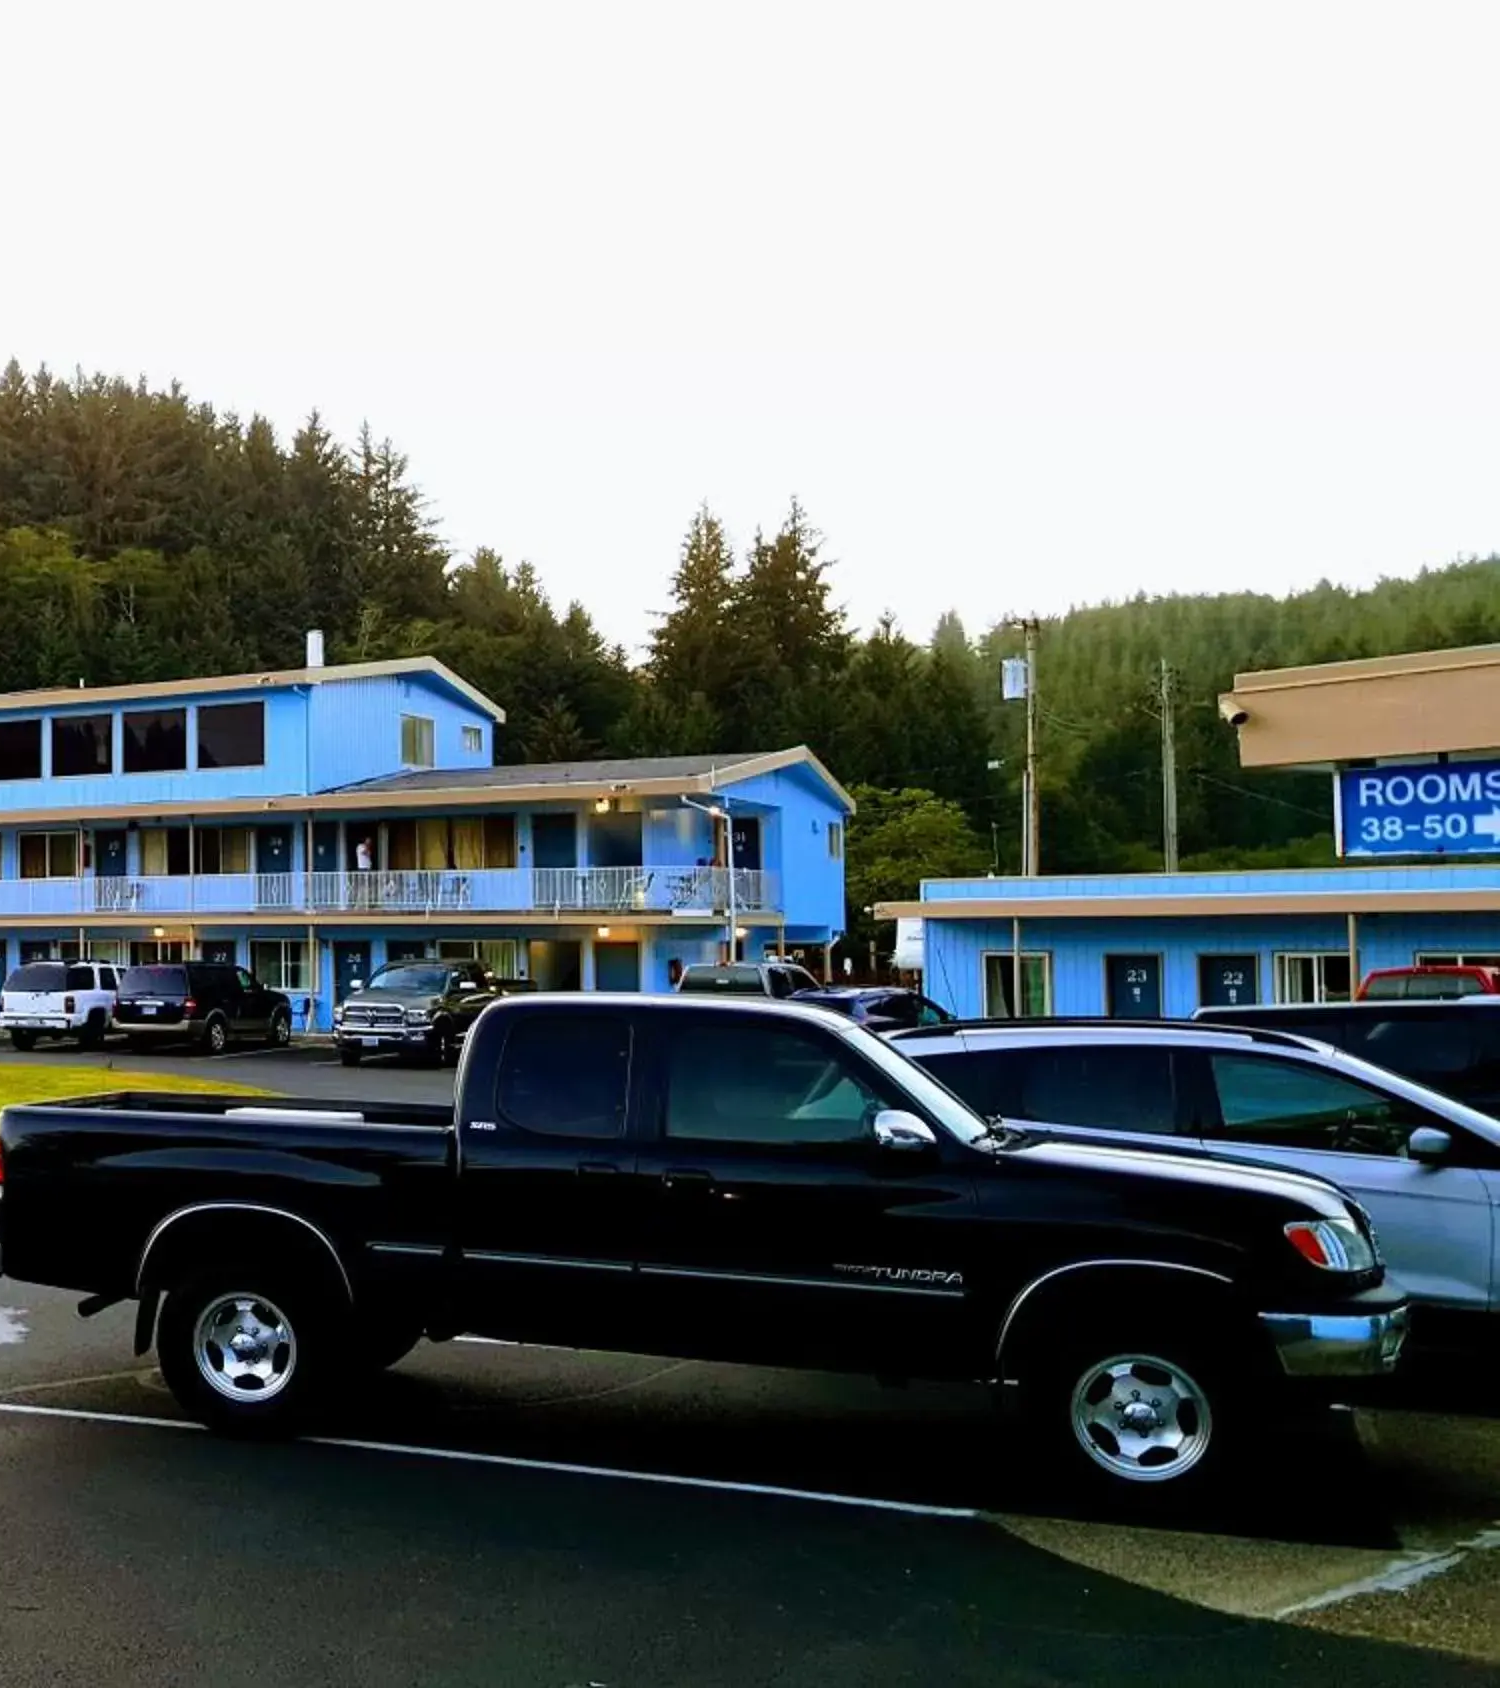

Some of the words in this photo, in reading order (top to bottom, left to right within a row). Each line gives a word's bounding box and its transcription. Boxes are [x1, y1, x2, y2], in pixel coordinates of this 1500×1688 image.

[1360, 813, 1468, 842] 38-50
[1126, 968, 1148, 983] 23
[1222, 970, 1244, 985] 22
[875, 1266, 963, 1285] TUNDRA
